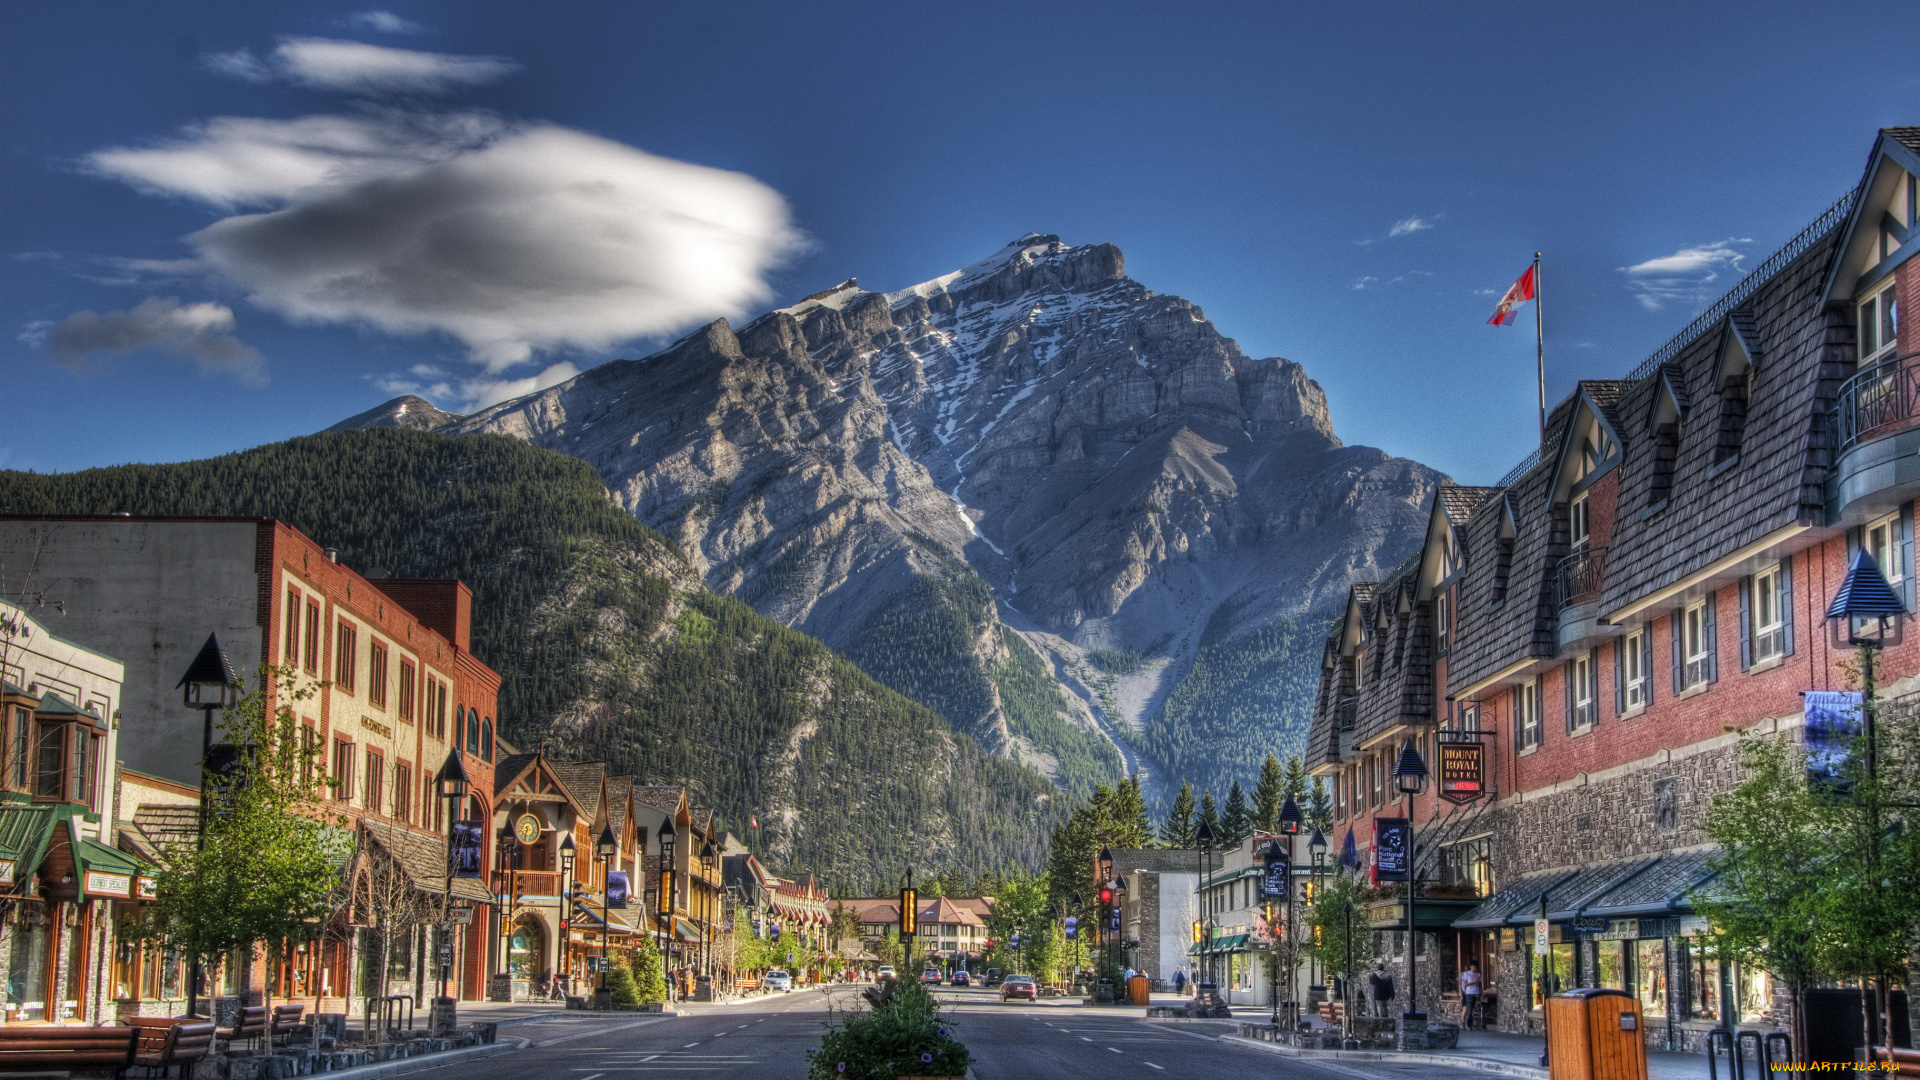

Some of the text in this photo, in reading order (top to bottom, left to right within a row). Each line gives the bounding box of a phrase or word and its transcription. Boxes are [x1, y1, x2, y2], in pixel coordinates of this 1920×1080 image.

[1444, 749, 1479, 760] MOUNT
[1446, 760, 1478, 770] ROYAL
[1445, 771, 1478, 779] HOTEL
[1379, 855, 1395, 863] Banff
